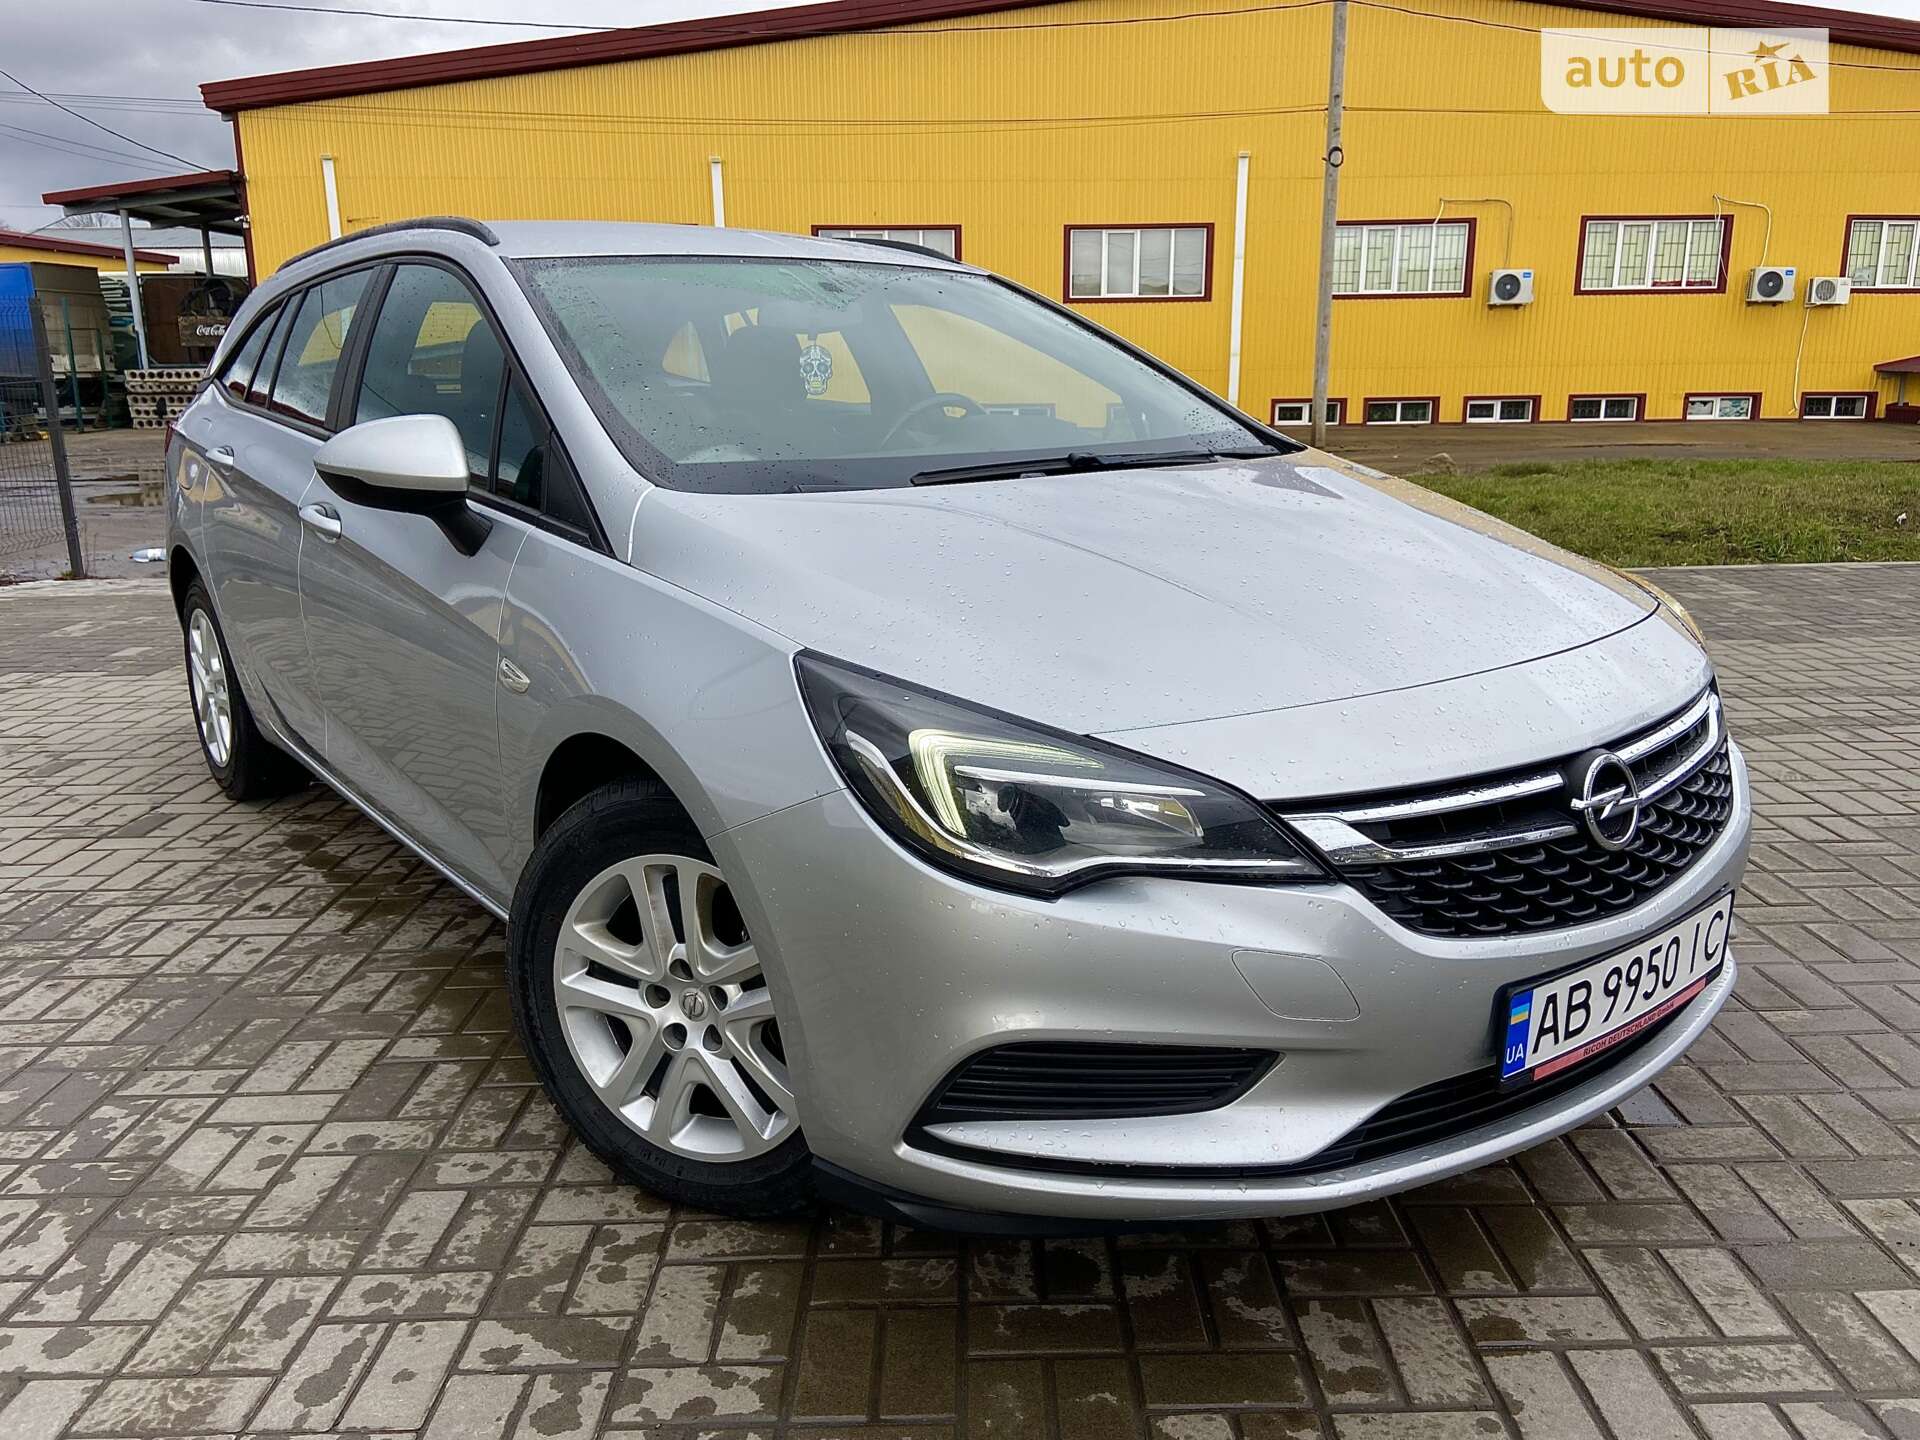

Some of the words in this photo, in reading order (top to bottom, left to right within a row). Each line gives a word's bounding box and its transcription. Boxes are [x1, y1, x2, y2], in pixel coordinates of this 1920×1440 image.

[1532, 980, 1592, 1055] AB
[1601, 936, 1681, 1024] 9950
[1689, 910, 1724, 975] IC
[1505, 1043, 1525, 1065] UA
[1583, 1039, 1607, 1057] RICOH
[1608, 1014, 1657, 1044] DEUTSCHLAND
